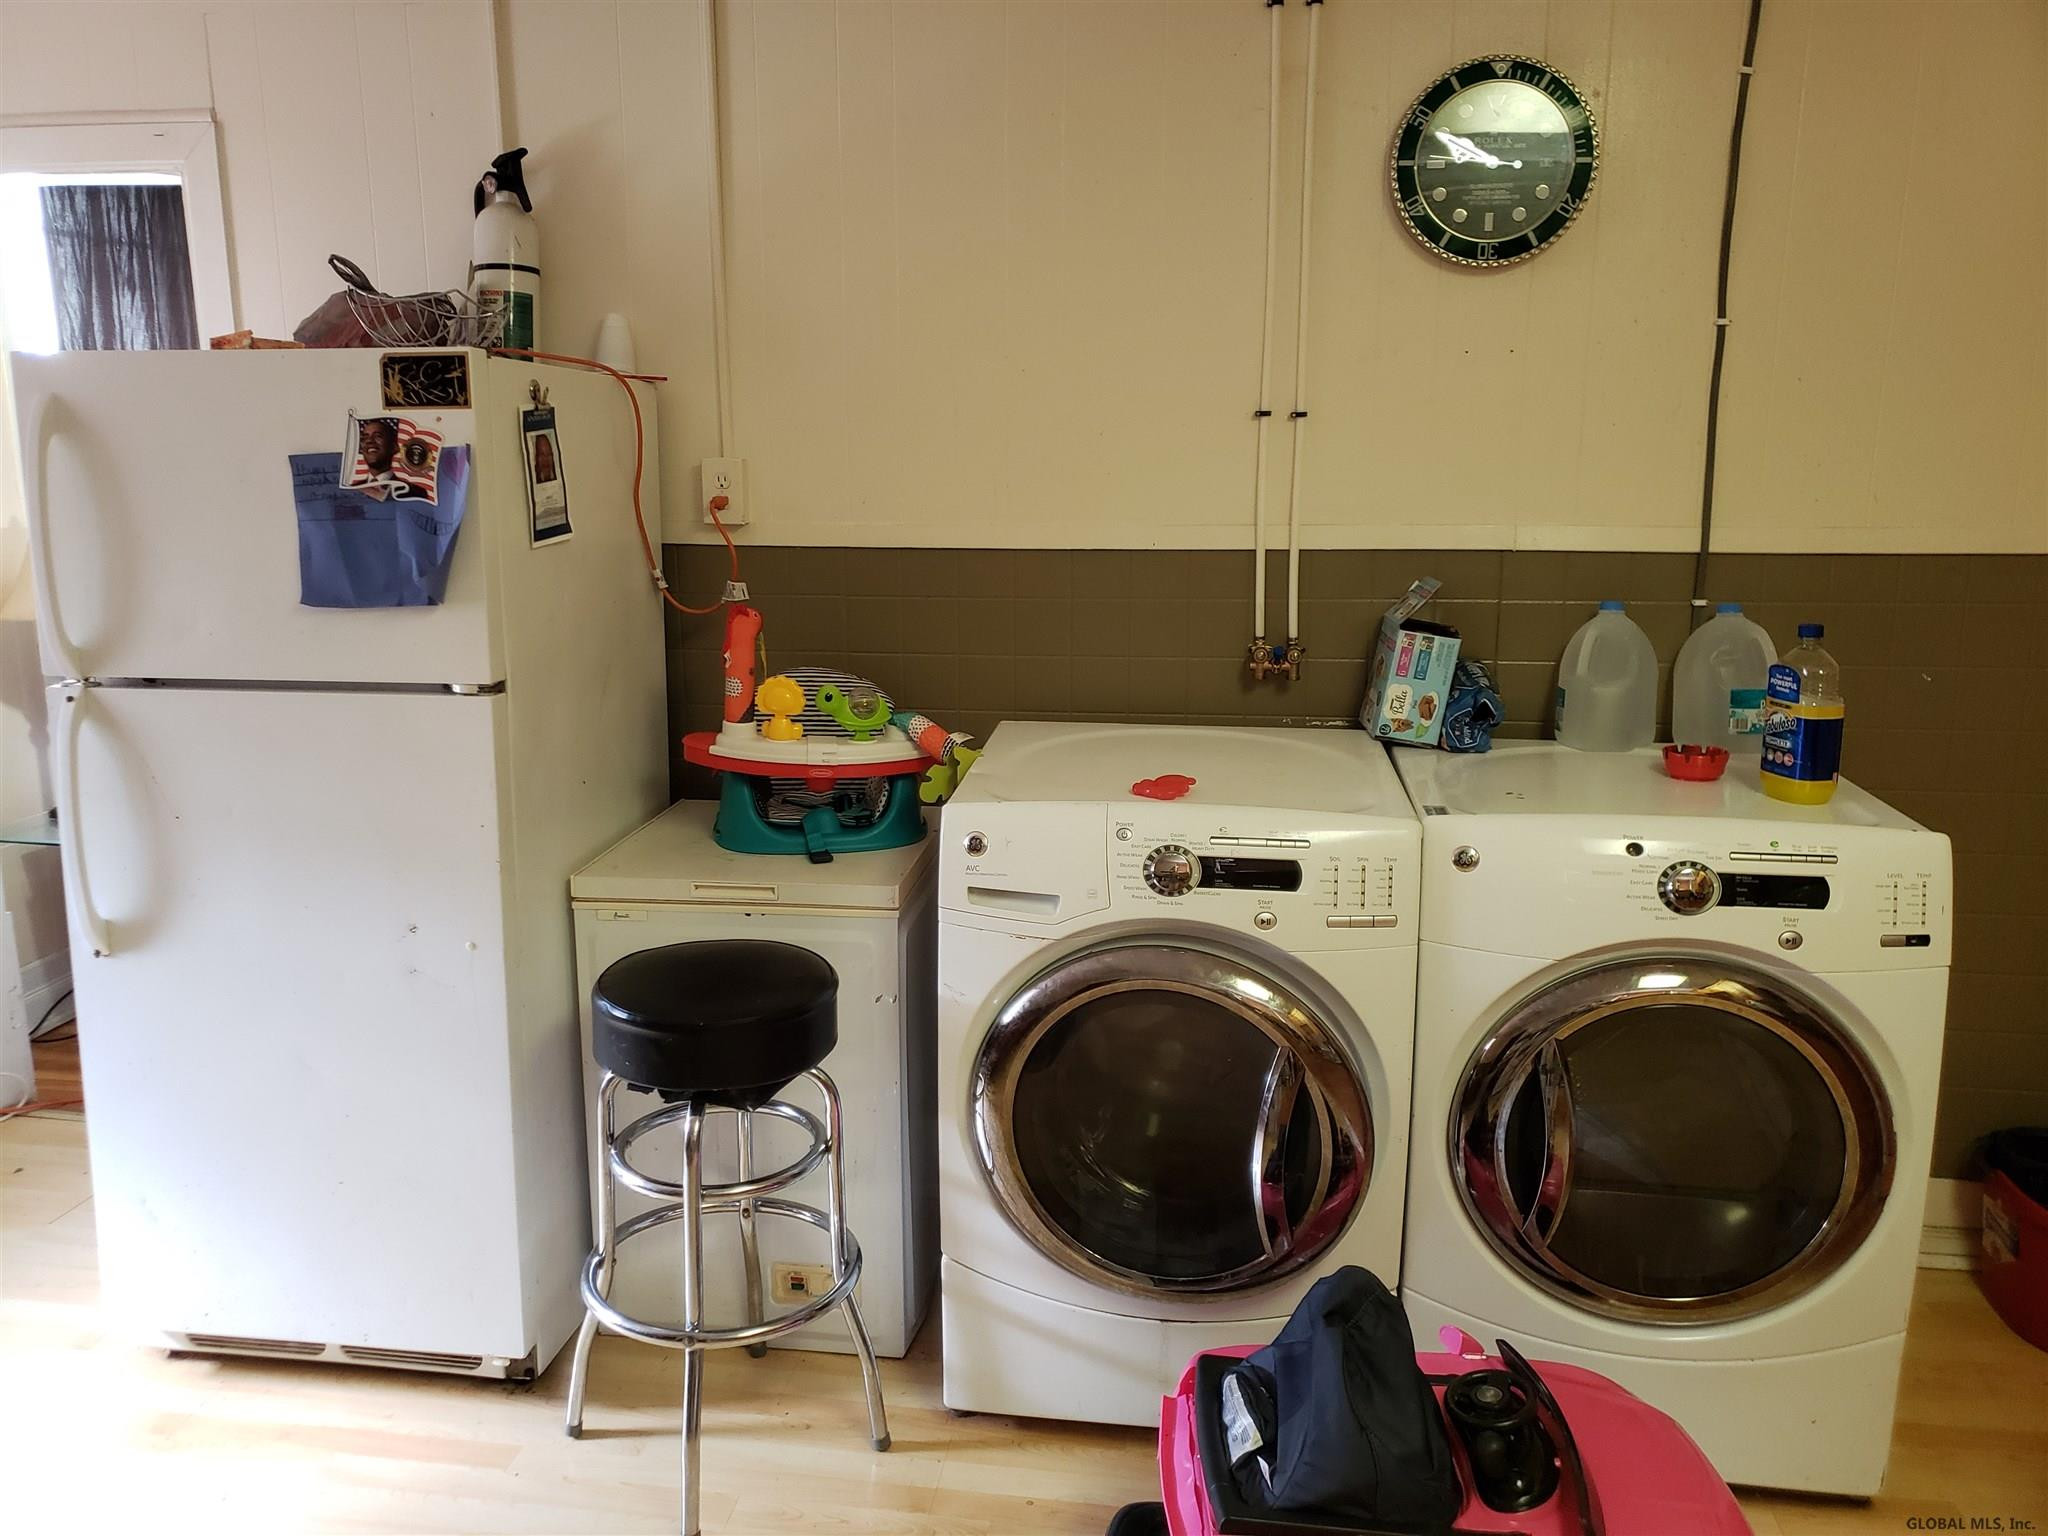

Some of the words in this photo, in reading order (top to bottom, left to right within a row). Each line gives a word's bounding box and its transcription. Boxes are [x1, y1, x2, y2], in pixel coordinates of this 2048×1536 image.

[1409, 107, 1432, 130] 50
[1474, 135, 1513, 145] ROLEX
[1406, 197, 1425, 216] 40
[1556, 193, 1580, 217] 20
[1477, 242, 1499, 259] 30
[1770, 677, 1798, 690] POWERFUL
[1391, 689, 1409, 716] Bella
[965, 864, 981, 872] AVC
